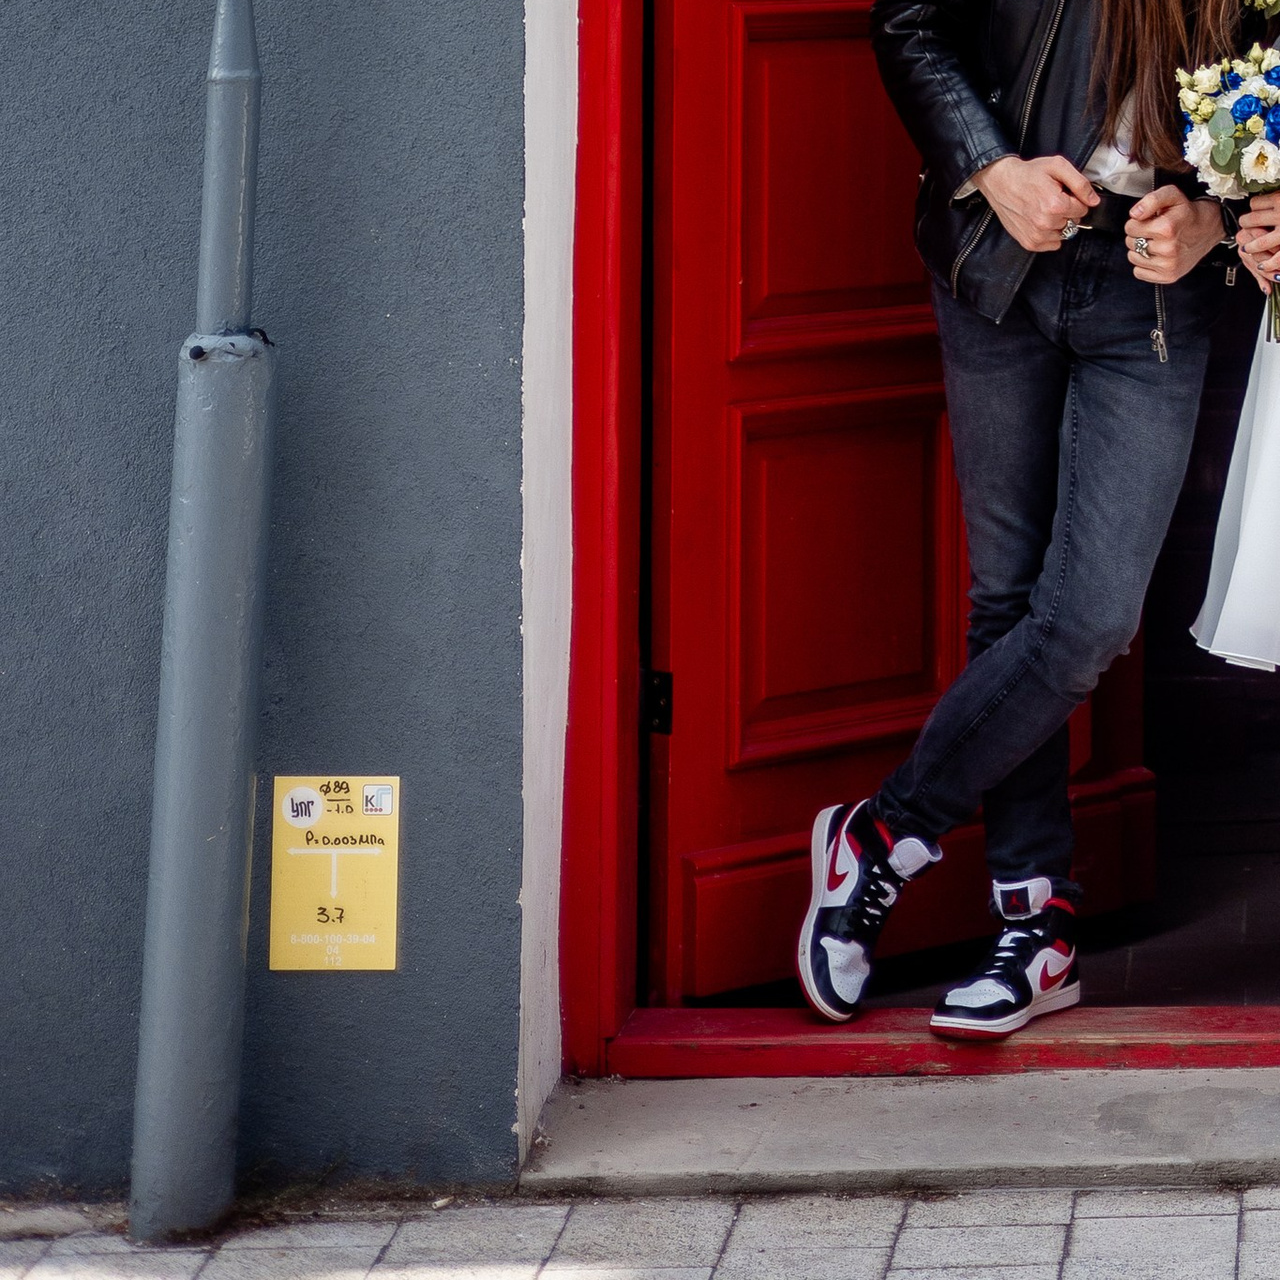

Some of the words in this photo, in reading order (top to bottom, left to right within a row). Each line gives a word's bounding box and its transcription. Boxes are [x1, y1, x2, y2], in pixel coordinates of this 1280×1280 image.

[316, 906, 345, 923] 3.7
[326, 945, 339, 955] 04
[324, 956, 342, 966] 112
